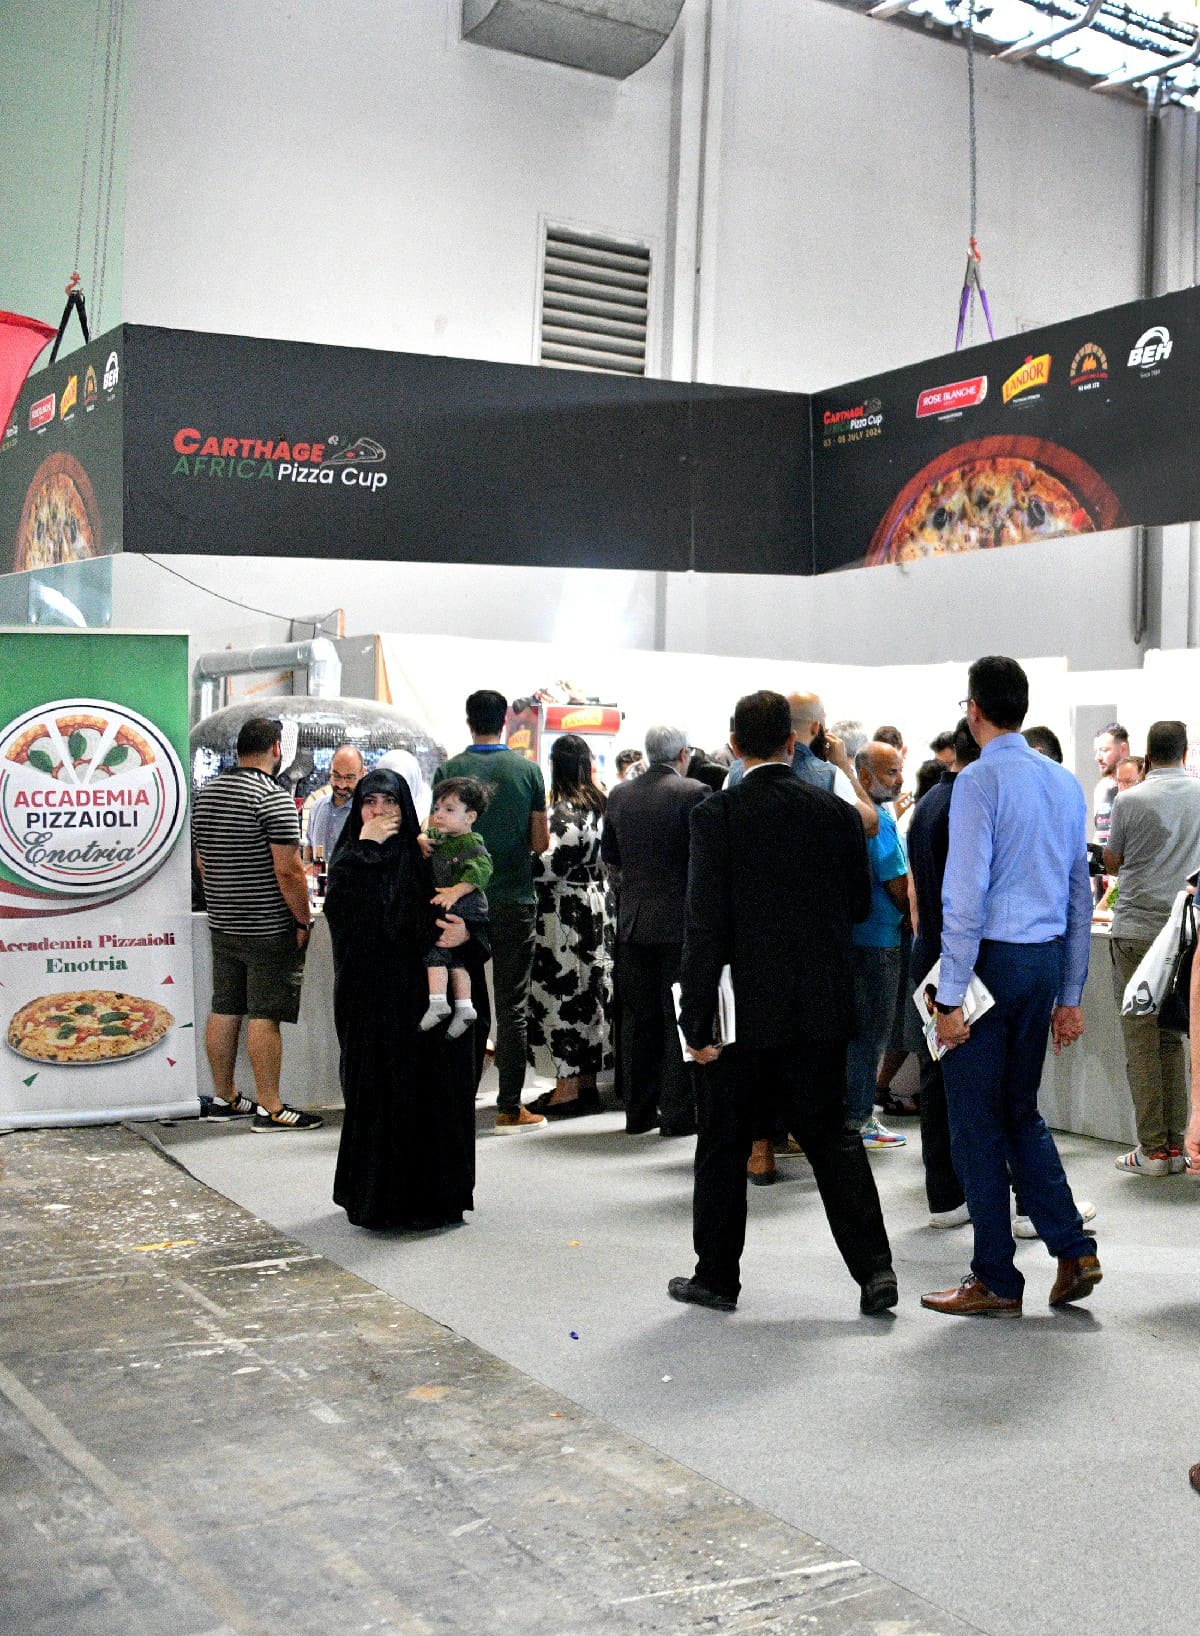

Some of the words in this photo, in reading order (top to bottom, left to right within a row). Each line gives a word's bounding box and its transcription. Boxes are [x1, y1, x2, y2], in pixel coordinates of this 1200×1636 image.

[1127, 341, 1173, 367] BEH
[1005, 361, 1044, 399] LANDOR
[922, 394, 942, 407] ROSE
[943, 385, 977, 401] BLANCHE
[868, 413, 883, 426] Cup
[847, 430, 865, 442] JULY
[171, 456, 275, 481] AFRICA
[277, 462, 334, 484] Pizza
[341, 467, 388, 492] Cup
[13, 789, 150, 808] ACCADEMIA
[27, 810, 138, 829] PIZZAIOLI
[23, 831, 136, 867] Enotria
[97, 932, 175, 948] Pizzaioli
[45, 956, 129, 974] Enotria
